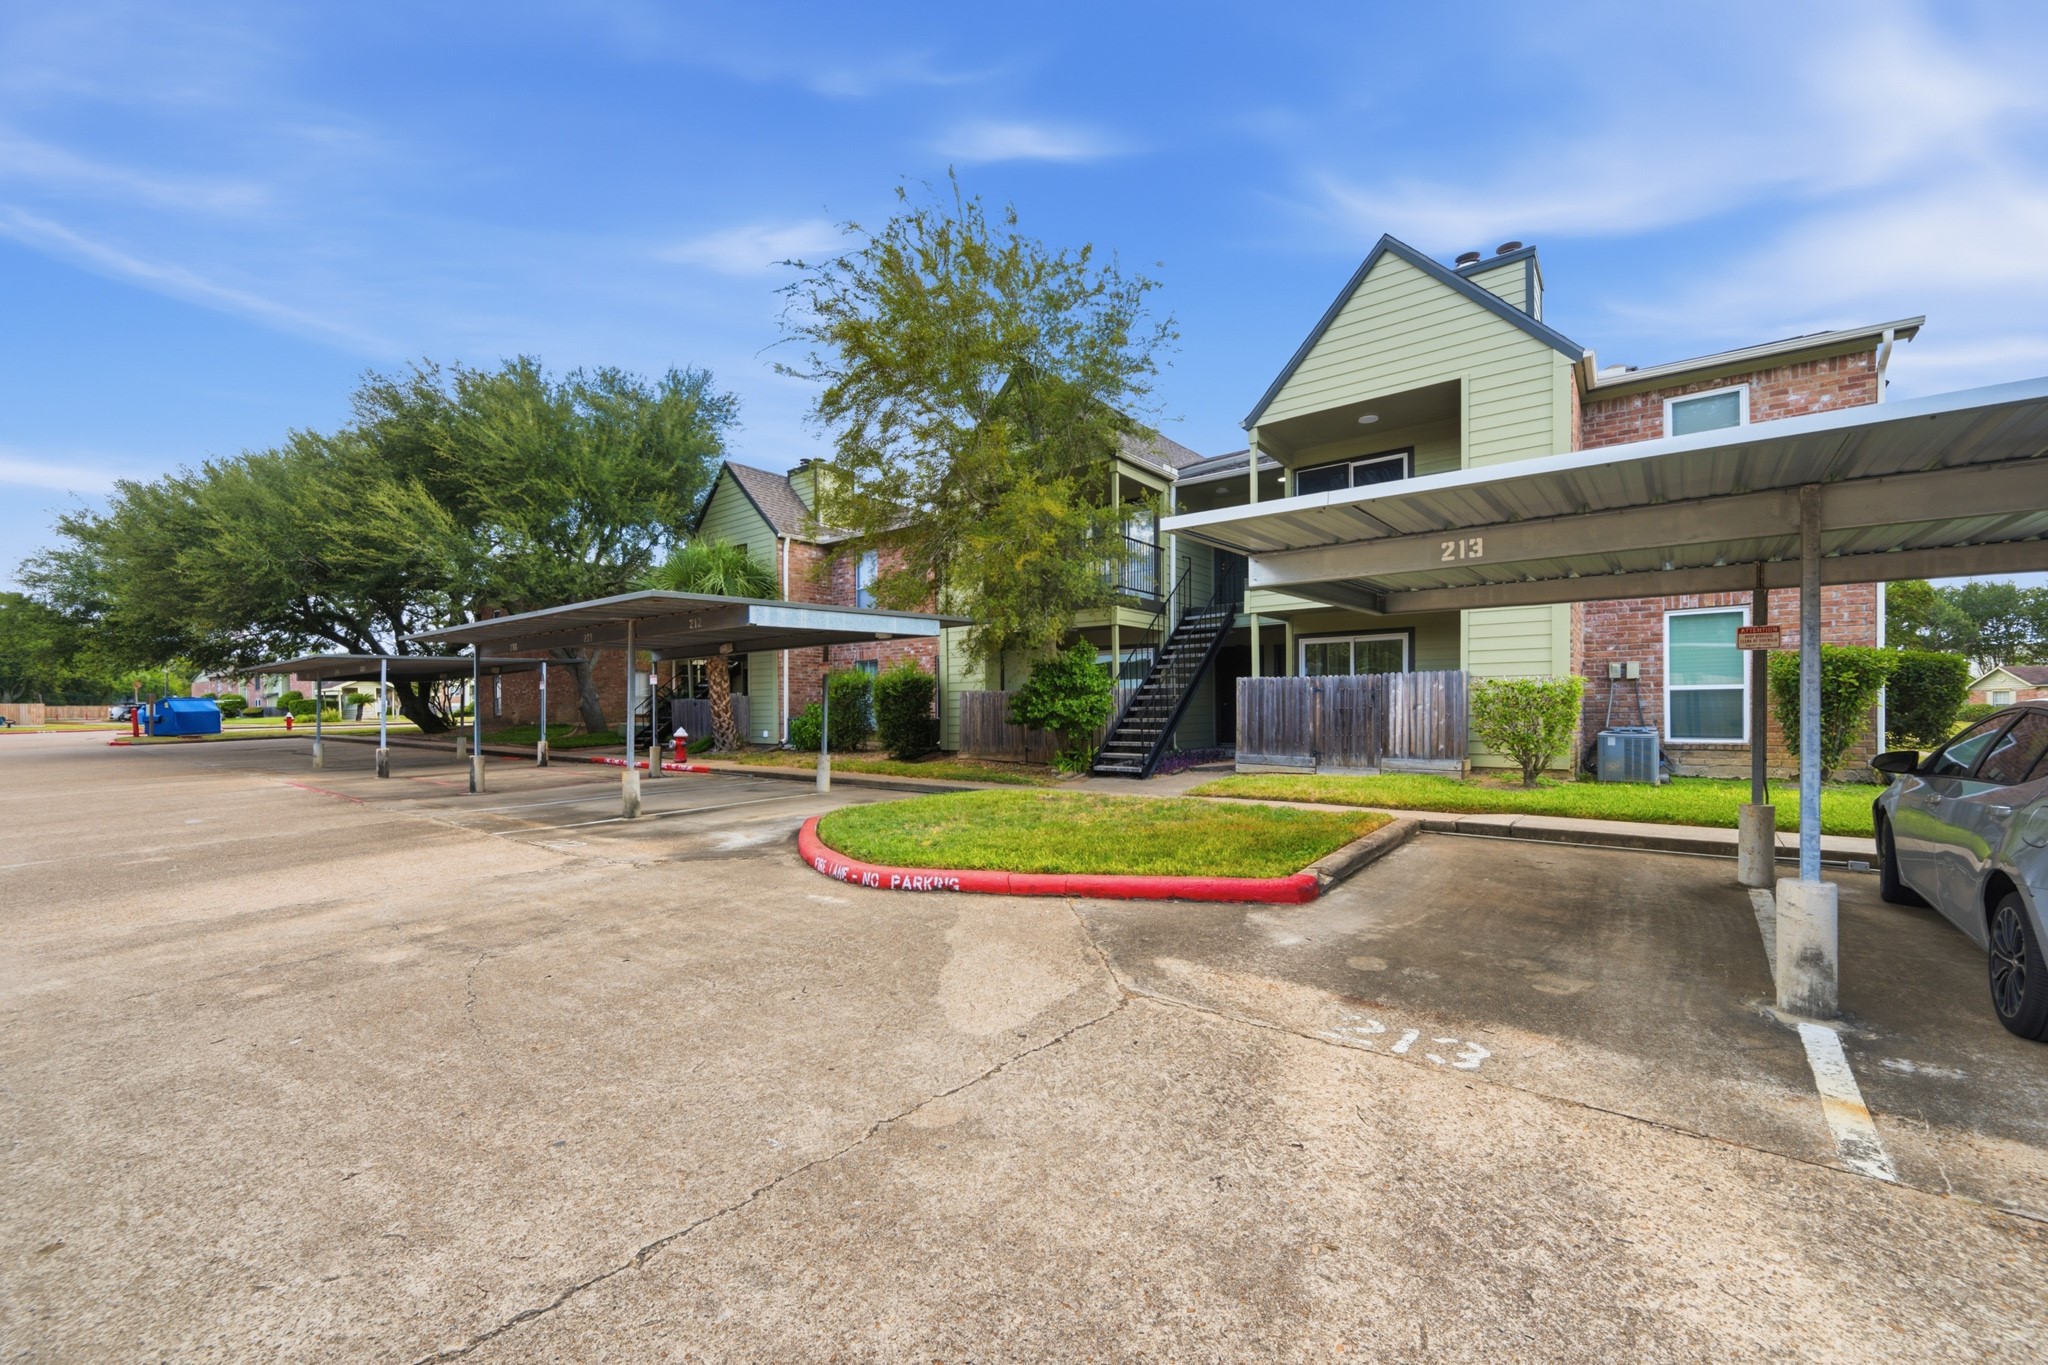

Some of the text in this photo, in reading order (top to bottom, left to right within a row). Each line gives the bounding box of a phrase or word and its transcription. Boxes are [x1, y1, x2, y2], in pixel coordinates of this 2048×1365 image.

[1441, 537, 1484, 562] 213
[689, 617, 703, 629] 212
[815, 857, 827, 874] FIRE
[828, 862, 849, 882] LANE
[862, 872, 880, 888] NO
[890, 874, 960, 891] PARKING
[1319, 1014, 1492, 1070] 213
